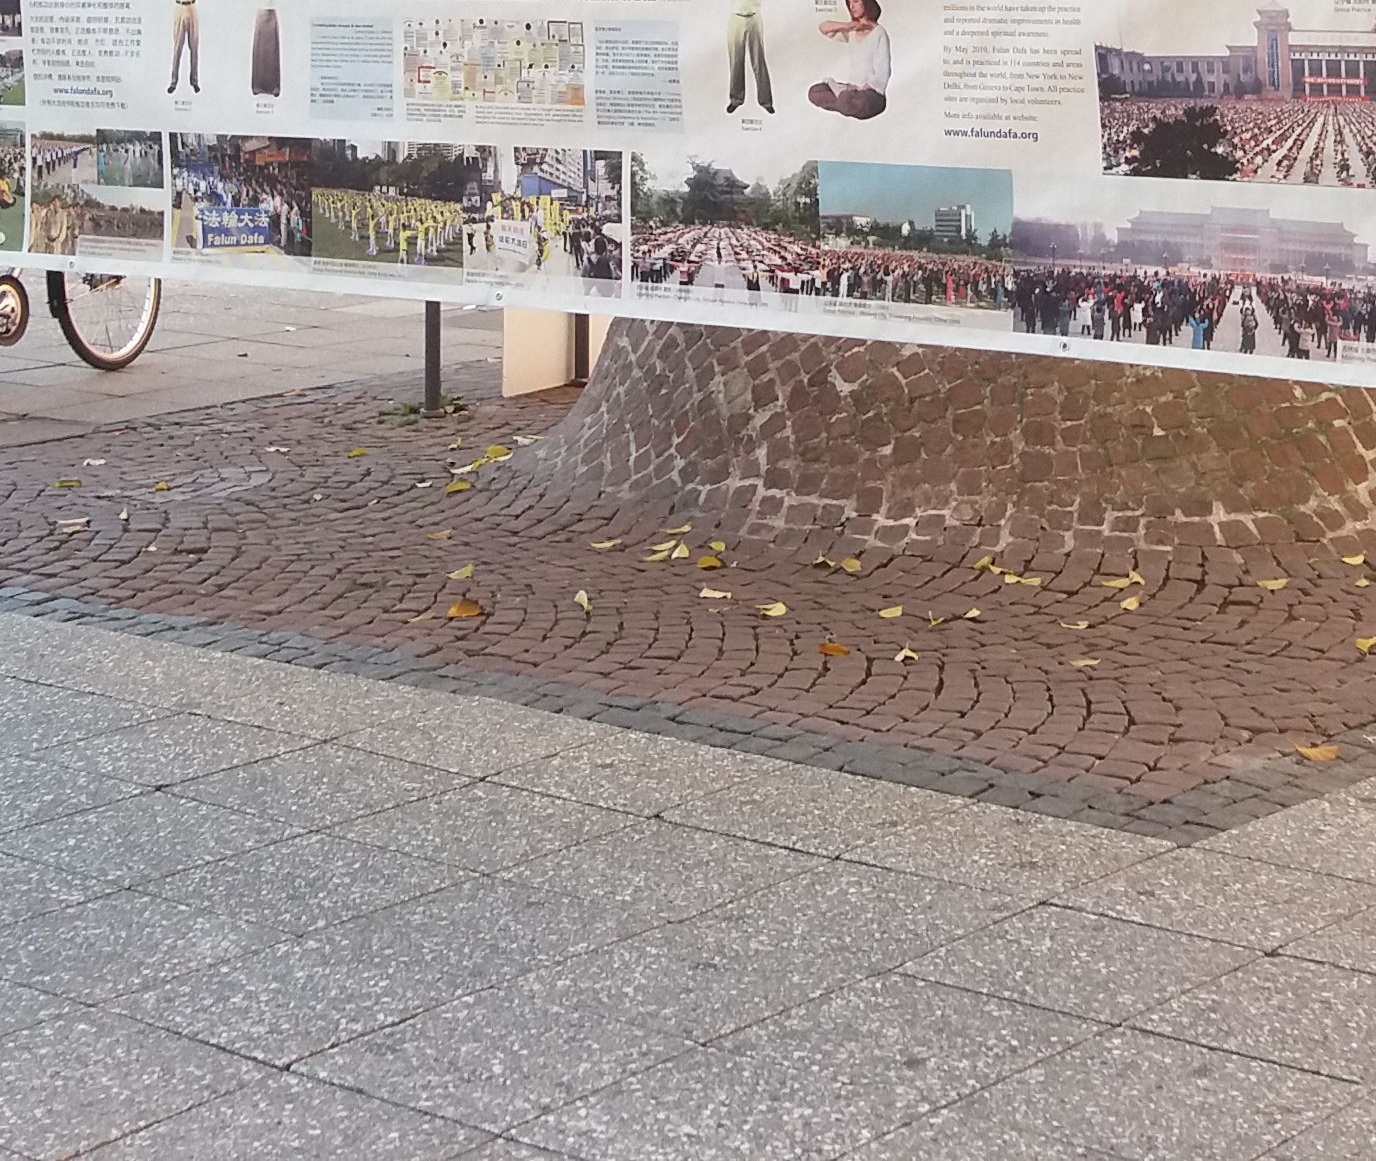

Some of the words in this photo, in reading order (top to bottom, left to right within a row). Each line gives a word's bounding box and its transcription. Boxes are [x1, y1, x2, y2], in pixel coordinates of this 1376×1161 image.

[944, 128, 1038, 142] www.falundafa.org
[207, 234, 237, 245] Falun
[240, 233, 264, 245] Dafa
